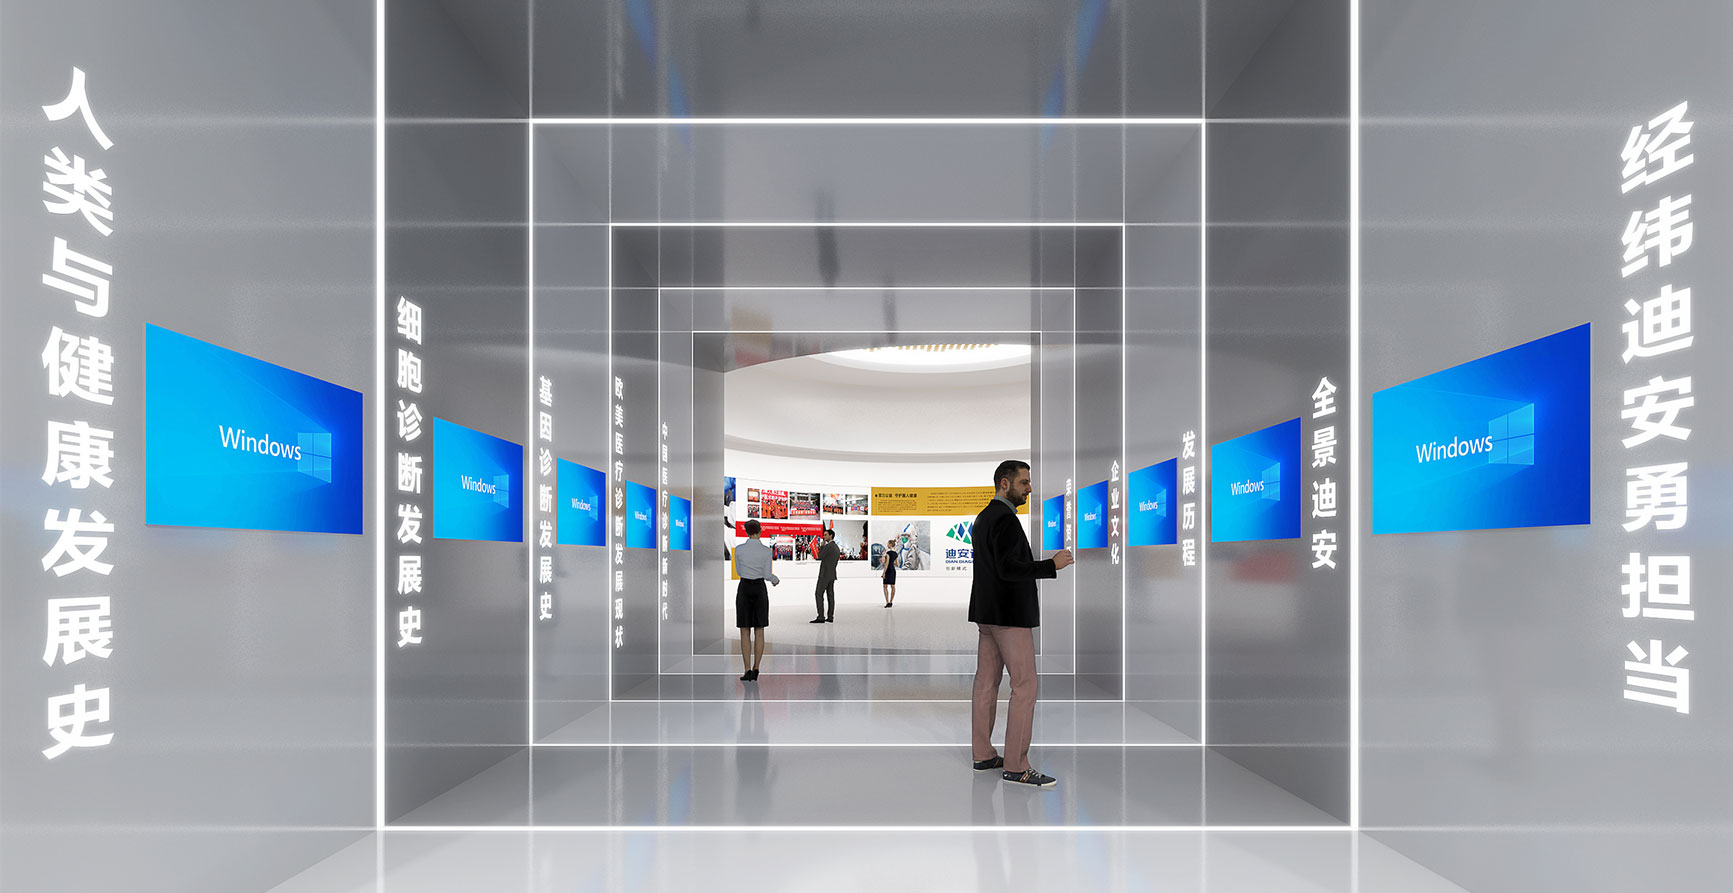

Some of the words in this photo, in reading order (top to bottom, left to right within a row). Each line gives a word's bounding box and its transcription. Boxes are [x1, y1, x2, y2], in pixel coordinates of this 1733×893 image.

[41, 66, 115, 760] 人类与健康发展史
[218, 424, 302, 462] Windows
[397, 296, 423, 648] 细胞诊断发展史
[1311, 376, 1337, 570] 全景迪安
[1415, 435, 1493, 464] Windows
[1620, 100, 1695, 715] 经纬迪安勇担当
[460, 475, 496, 496] Windows
[539, 375, 553, 621] 基因诊断发展史
[571, 497, 592, 512] Windows
[614, 375, 624, 649] 欧美医疗诊断发展现状
[661, 421, 669, 622] 中国医疗诊断新时代
[1110, 459, 1120, 565] 企业文化
[1138, 499, 1159, 512] Windows
[1182, 430, 1196, 567] 发展历程
[1230, 479, 1265, 496] Windows
